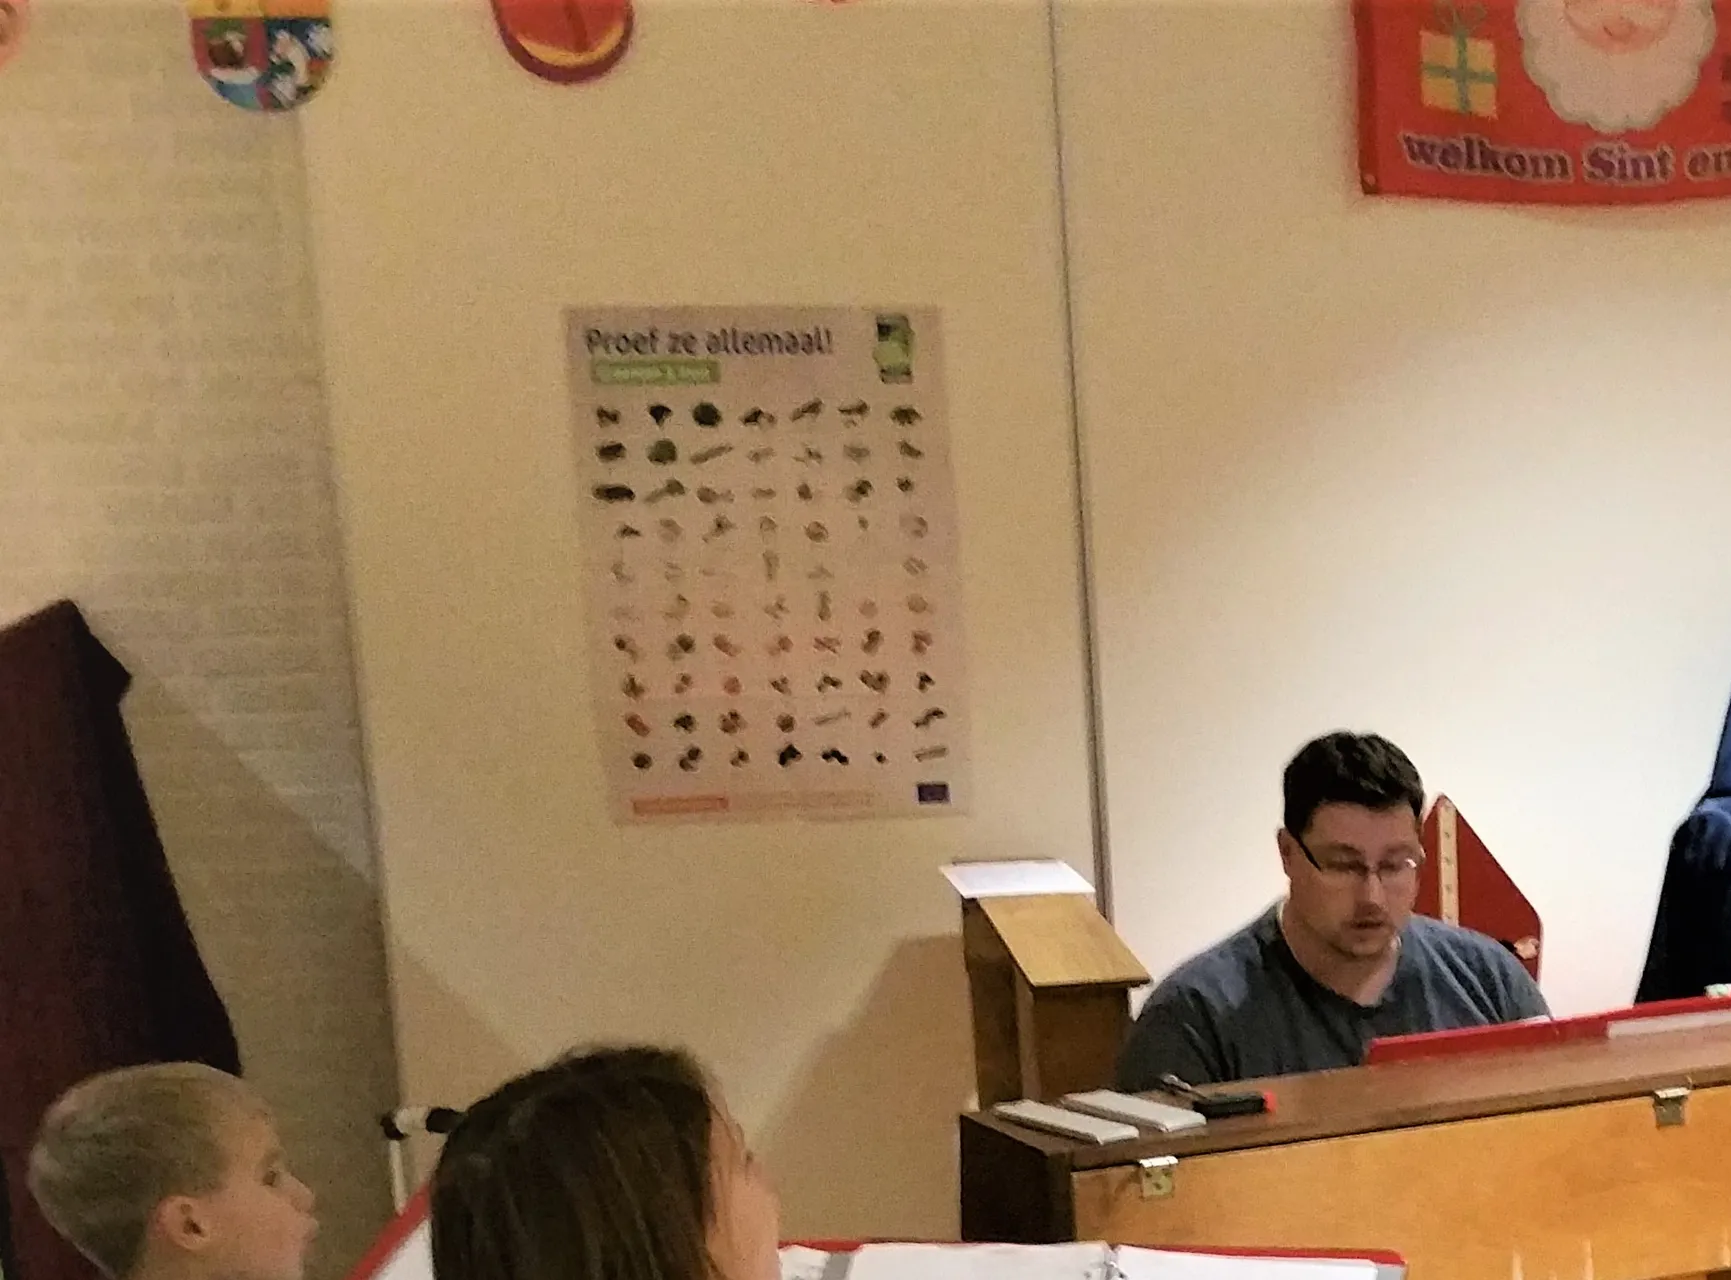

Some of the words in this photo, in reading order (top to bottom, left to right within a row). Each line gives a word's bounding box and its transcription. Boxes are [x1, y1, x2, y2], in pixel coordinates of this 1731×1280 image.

[1401, 134, 1572, 181] welkom
[1584, 143, 1674, 184] Sint
[586, 326, 659, 355] Proef
[667, 331, 698, 354] ze
[705, 326, 832, 356] allemaal!
